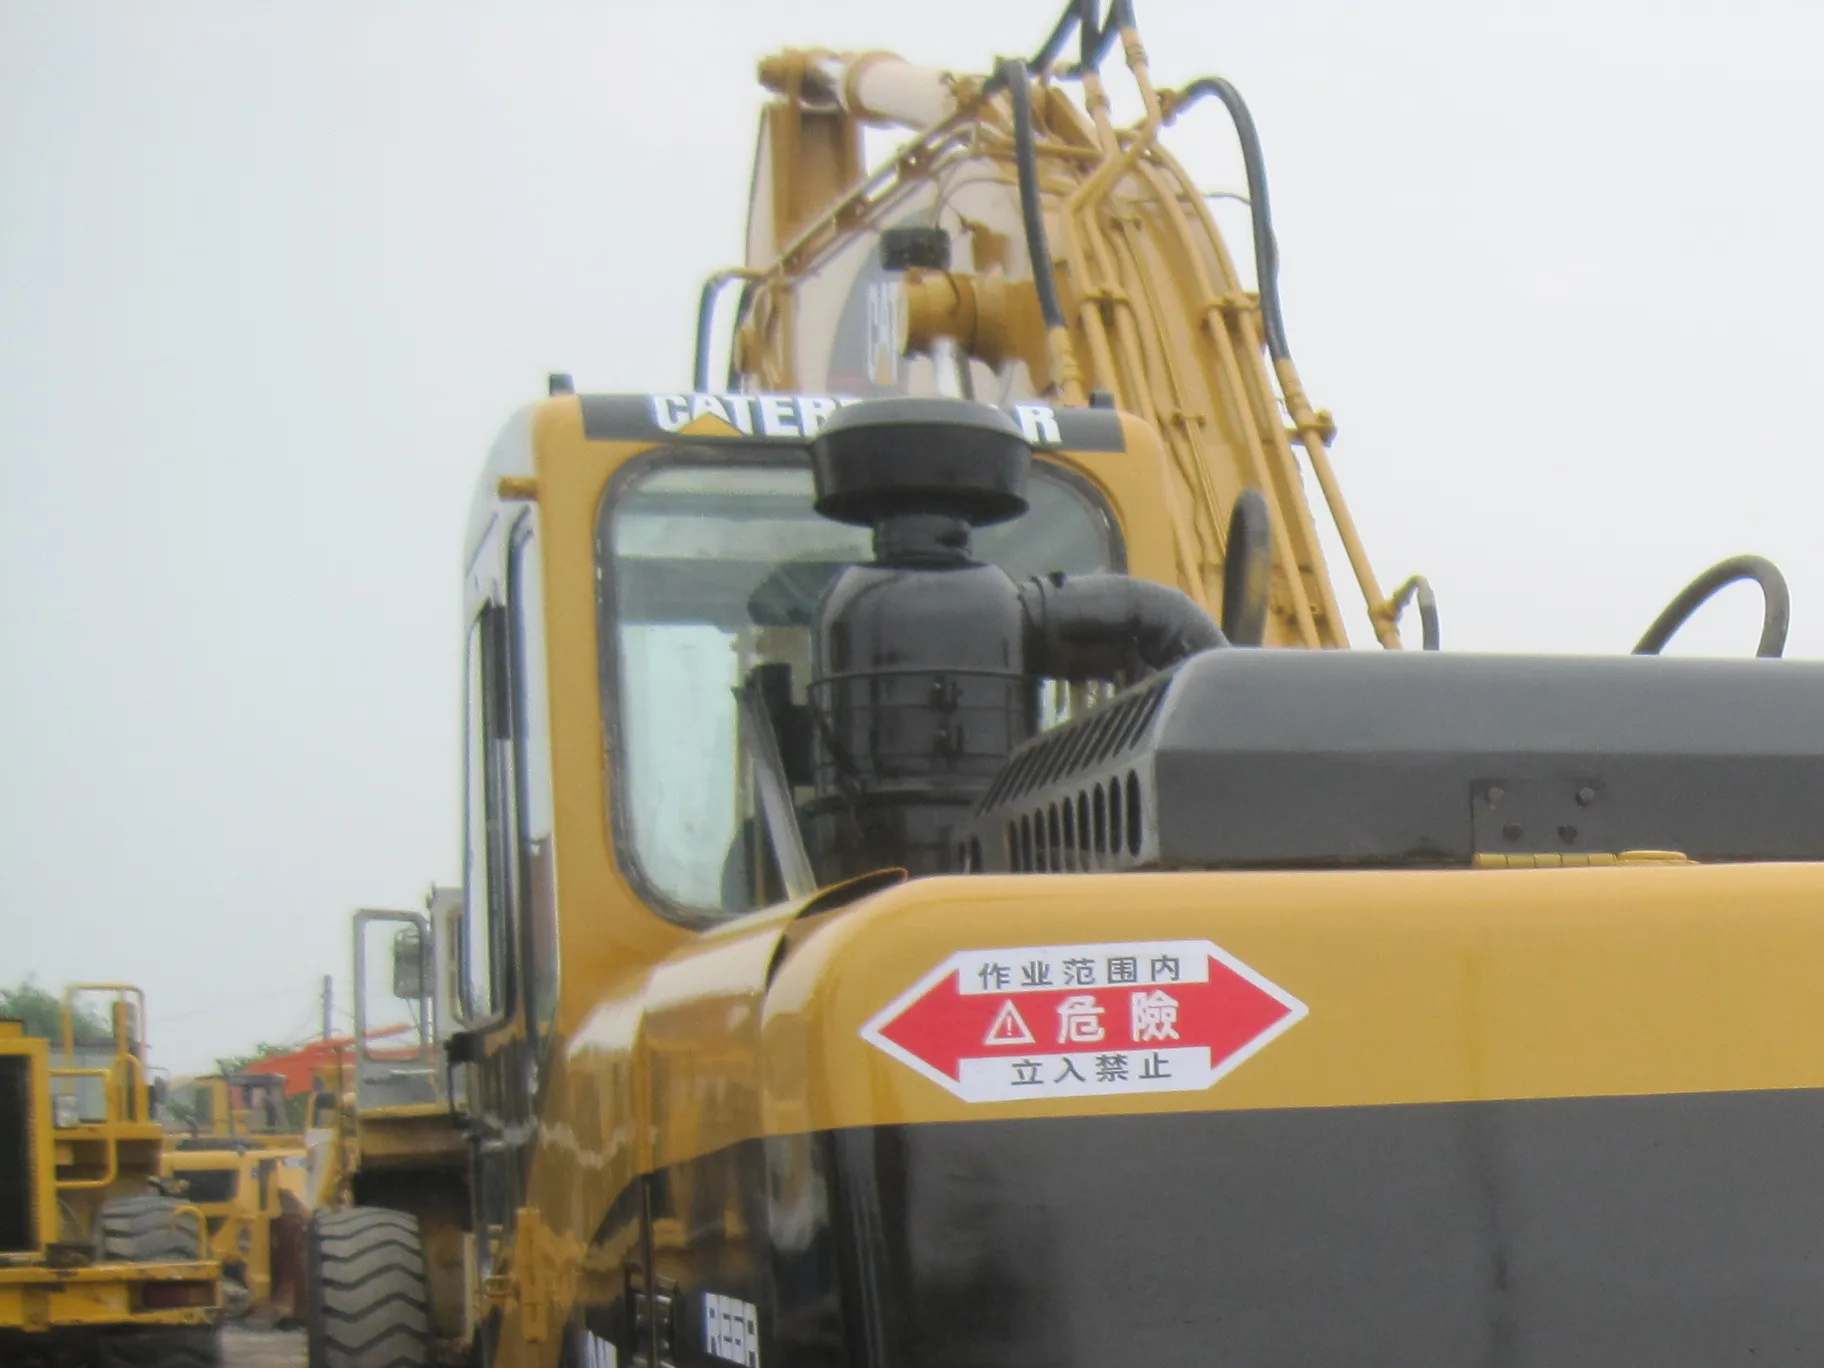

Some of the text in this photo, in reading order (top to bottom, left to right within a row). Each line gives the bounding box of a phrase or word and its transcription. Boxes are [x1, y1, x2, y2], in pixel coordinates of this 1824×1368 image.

[652, 394, 1062, 444] CATERR
[977, 953, 1181, 991] 作业范围内
[1055, 989, 1181, 1045] 危險
[1010, 1052, 1172, 1088] 立入禁止
